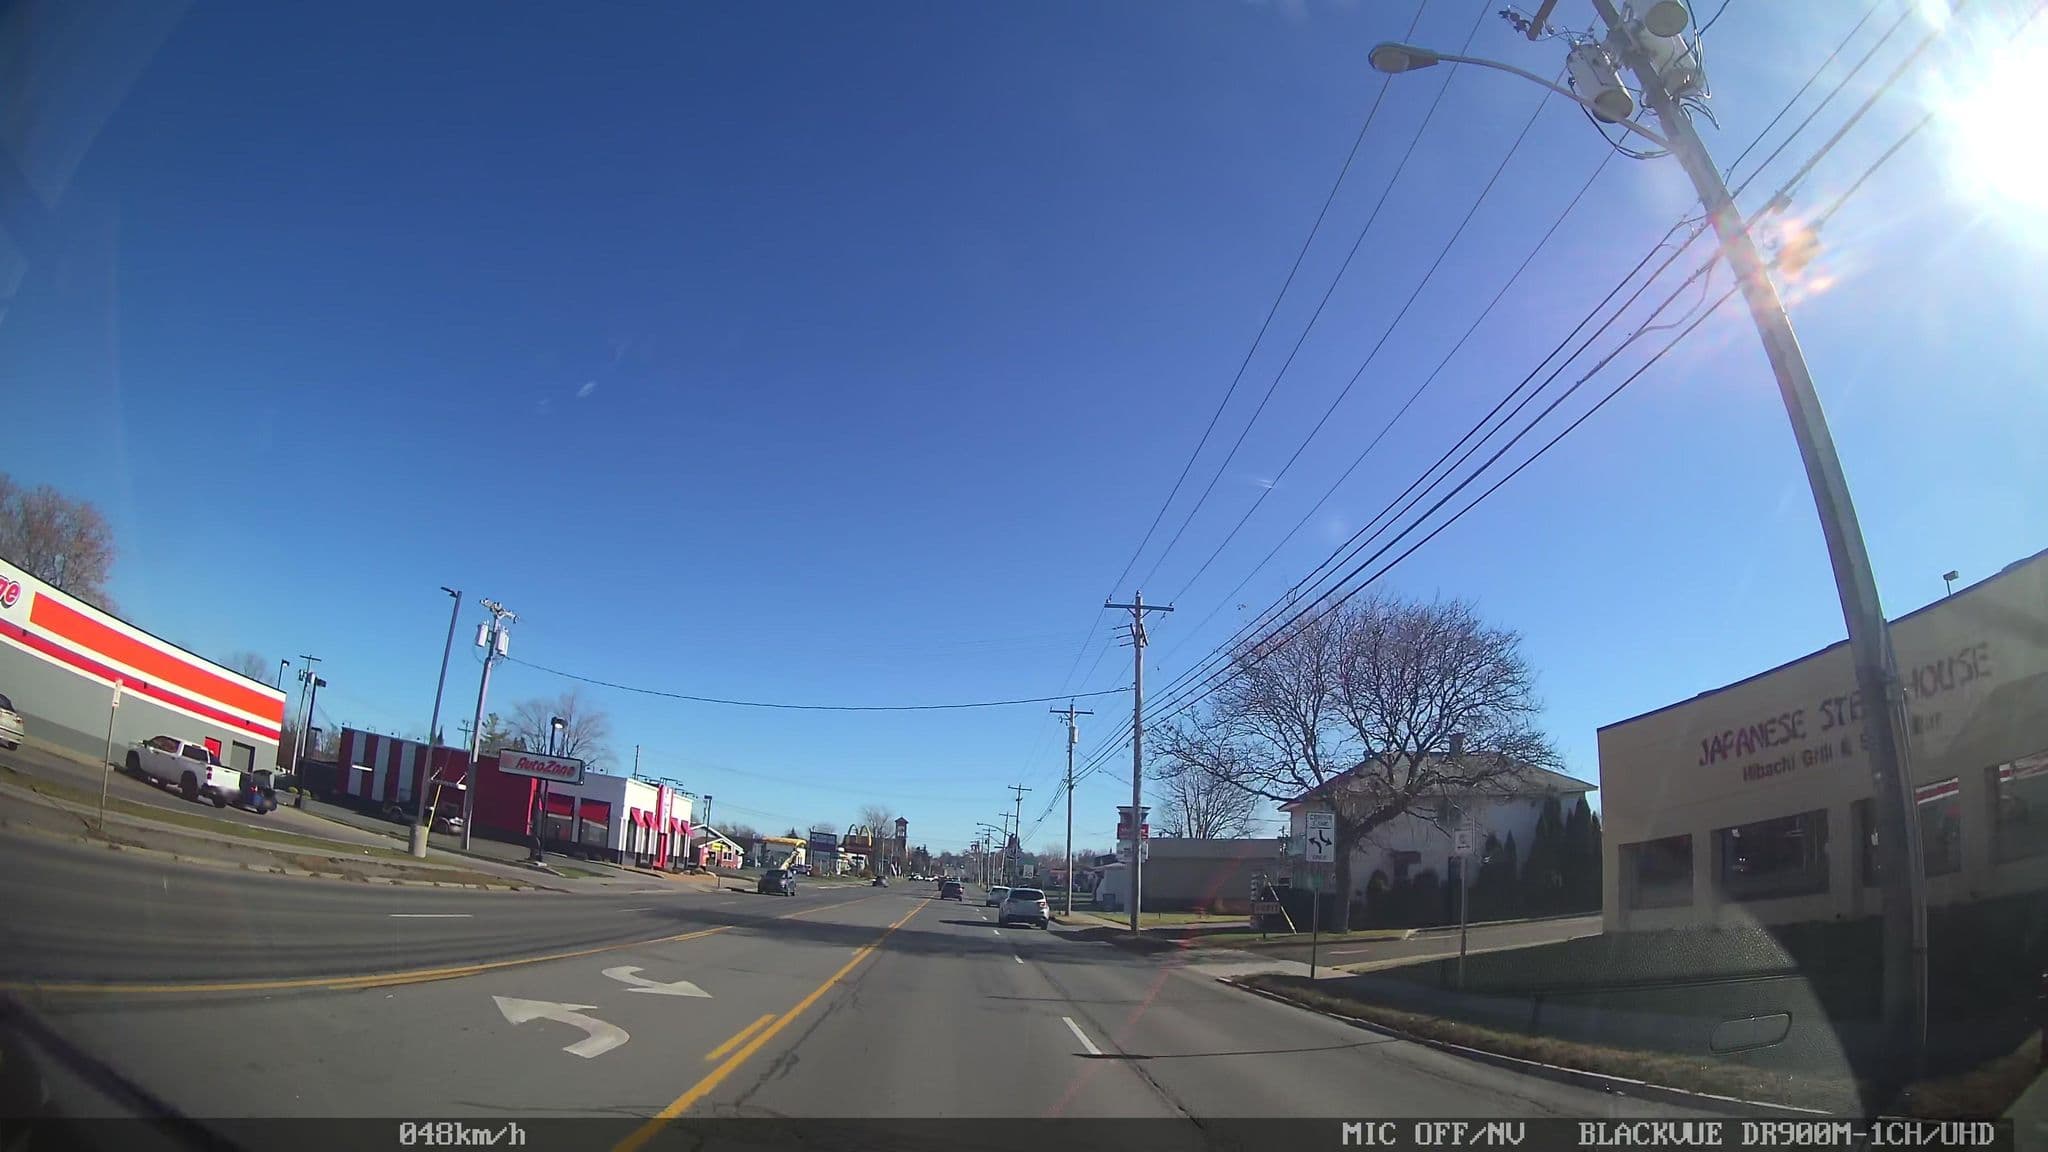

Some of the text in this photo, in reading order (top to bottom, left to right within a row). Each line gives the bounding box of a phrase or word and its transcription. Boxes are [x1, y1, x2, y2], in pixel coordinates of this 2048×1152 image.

[1699, 709, 1807, 767] JAPANESE
[516, 757, 576, 778] AutoZone
[1743, 755, 1796, 782] Hibachi
[1802, 742, 1833, 768] Grill
